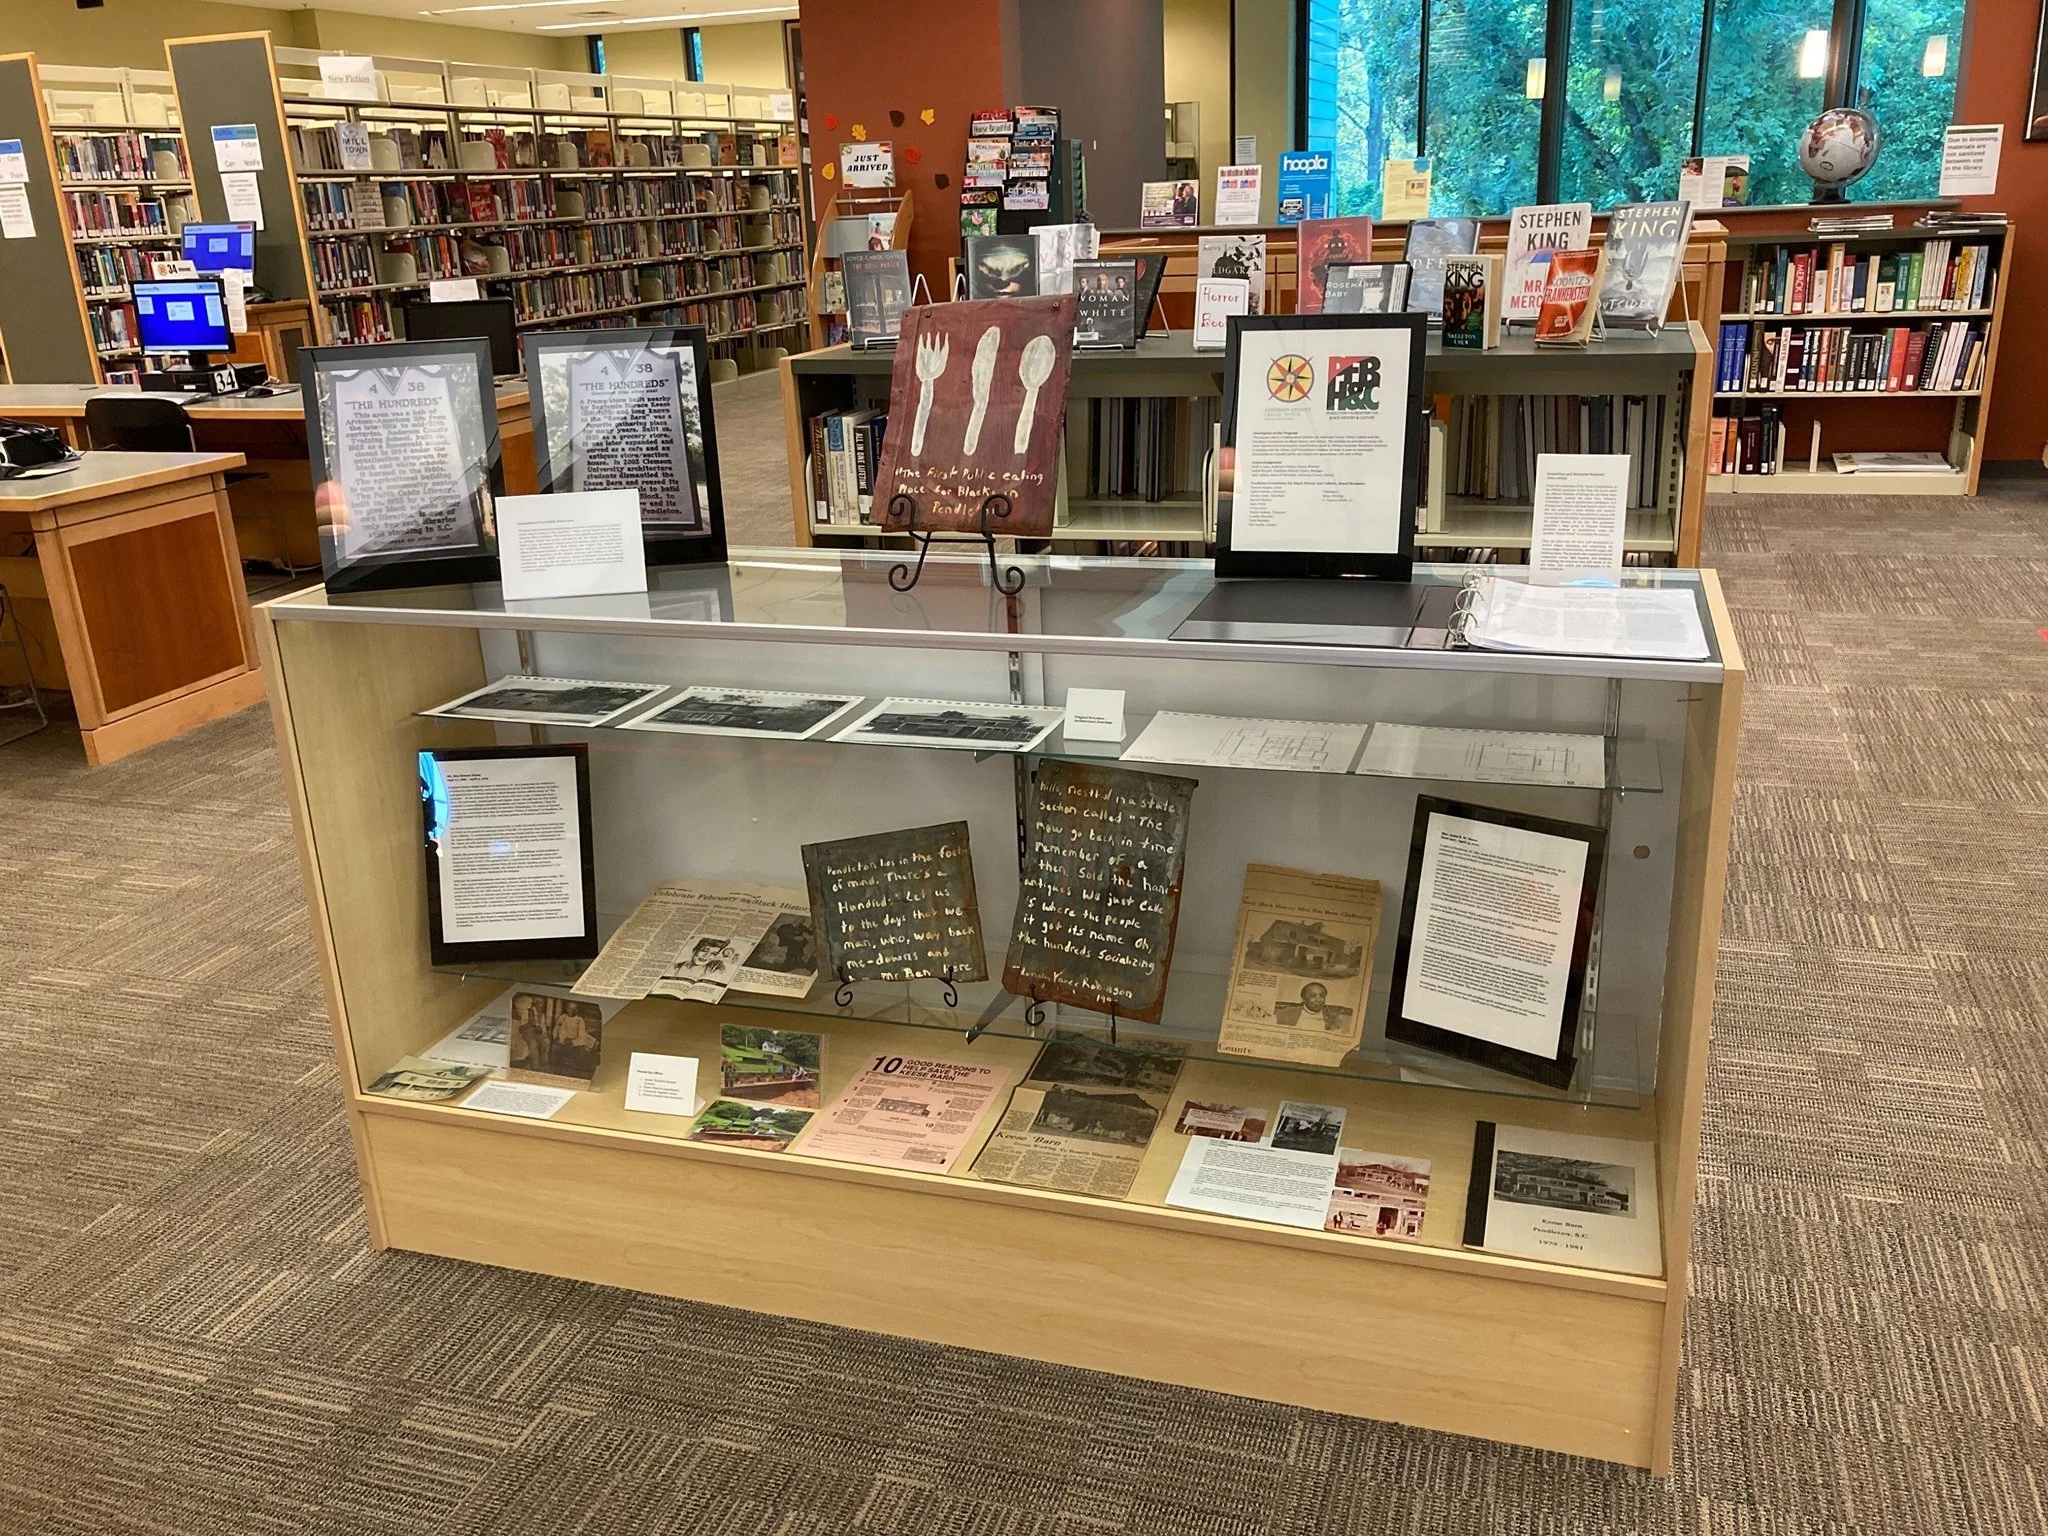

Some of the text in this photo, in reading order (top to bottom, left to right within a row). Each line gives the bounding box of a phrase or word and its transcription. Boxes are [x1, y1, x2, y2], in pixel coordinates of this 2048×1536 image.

[328, 75, 370, 83] New Fiction
[345, 146, 368, 154] TOWN
[854, 154, 880, 162] JUST
[847, 163, 888, 172] ARRIVED
[1283, 154, 1328, 174] hoopla
[1520, 211, 1582, 229] STEPHEN
[1619, 206, 1682, 218] STEPHEN
[1614, 219, 1677, 240] KING
[1527, 232, 1569, 251] KING
[167, 264, 178, 274] 34
[1446, 263, 1484, 272] STEPHEN
[1445, 272, 1484, 288] KING
[1795, 264, 1805, 292] MERCK
[1203, 287, 1240, 304] Horror
[1325, 290, 1349, 298] BABY
[1544, 285, 1591, 301] FRANKENSTEIN
[1080, 309, 1126, 317] WHITE
[601, 364, 653, 375] 4 38
[216, 371, 236, 392] 34
[369, 382, 425, 394] 4 38
[610, 379, 669, 390] HUNDREDS"
[345, 397, 442, 410] "THE HUNDREDS"
[856, 433, 864, 442] ALL
[857, 452, 866, 464] ONE
[858, 465, 867, 490] LIFETIME
[926, 466, 958, 480] First
[962, 468, 996, 480] Public
[1002, 470, 1044, 486] eating
[1141, 799, 1176, 813] state
[1083, 808, 1122, 824] called
[1036, 821, 1063, 834] now
[1070, 828, 1083, 842] go
[1121, 836, 1133, 847] in
[1140, 837, 1174, 854] time
[827, 862, 876, 875] Pendleton
[900, 857, 908, 865] in
[913, 852, 933, 863] the
[1035, 841, 1148, 870] remember of a
[832, 881, 843, 892] of
[884, 869, 931, 882] There's
[1111, 872, 1134, 887] the
[652, 890, 776, 908] Celebrate February Black
[906, 889, 926, 902] Let
[1024, 878, 1071, 896] antiques
[1107, 893, 1135, 907] just
[841, 907, 963, 933] to the days that we
[1026, 895, 1141, 929] is where the people
[1024, 913, 1034, 925] it
[1042, 921, 1062, 934] got
[1068, 924, 1084, 936] its
[1090, 930, 1125, 945] name
[843, 926, 975, 950] man, who, way back
[1017, 931, 1037, 946] the
[1043, 936, 1091, 958] hundreds
[927, 947, 950, 958] and
[903, 967, 931, 980] Ben
[1218, 1042, 1252, 1055] County
[872, 1055, 903, 1074] 10
[935, 1063, 977, 1073] REASONS
[899, 1070, 928, 1078] KEESE
[995, 1131, 1027, 1141] Keese
